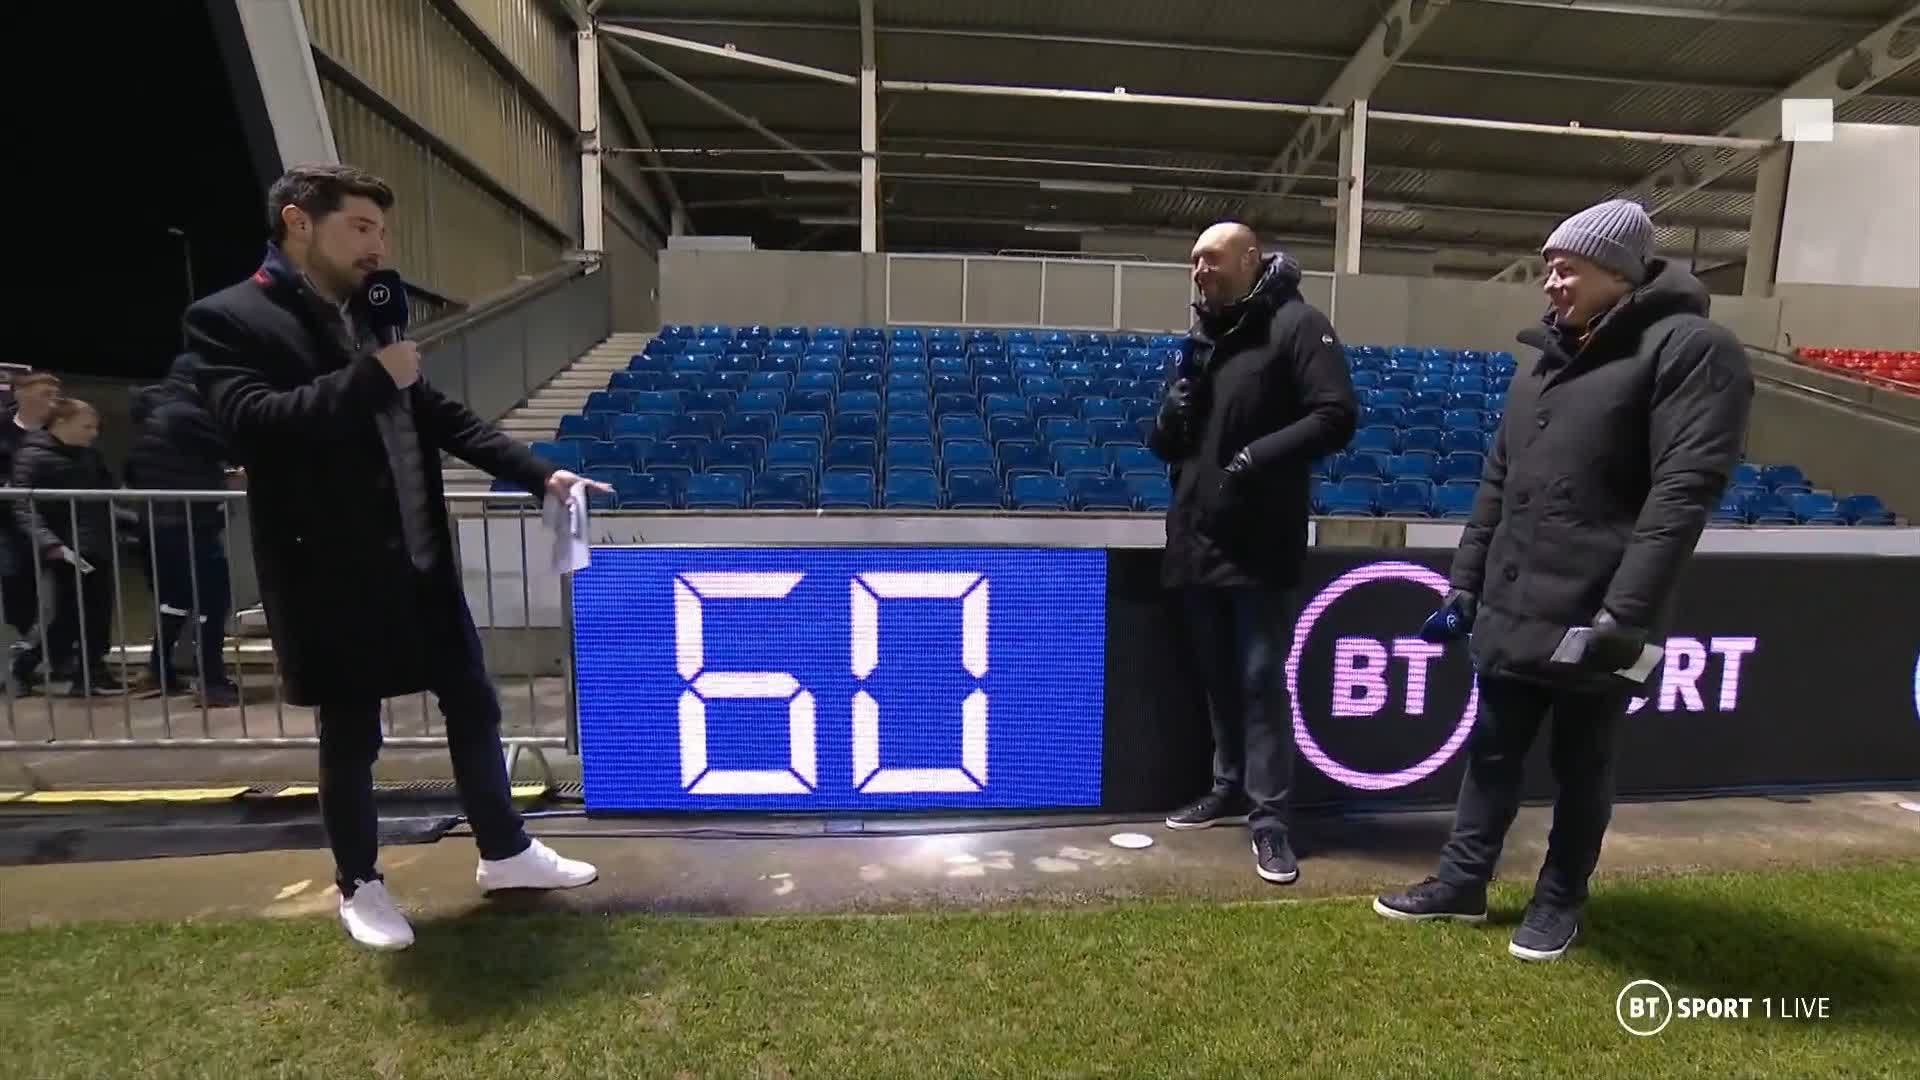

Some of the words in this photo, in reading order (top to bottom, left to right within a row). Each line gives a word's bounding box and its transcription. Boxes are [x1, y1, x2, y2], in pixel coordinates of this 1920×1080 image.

[673, 571, 990, 795] 60
[1331, 637, 1444, 716] BT
[1626, 636, 1757, 714] RT
